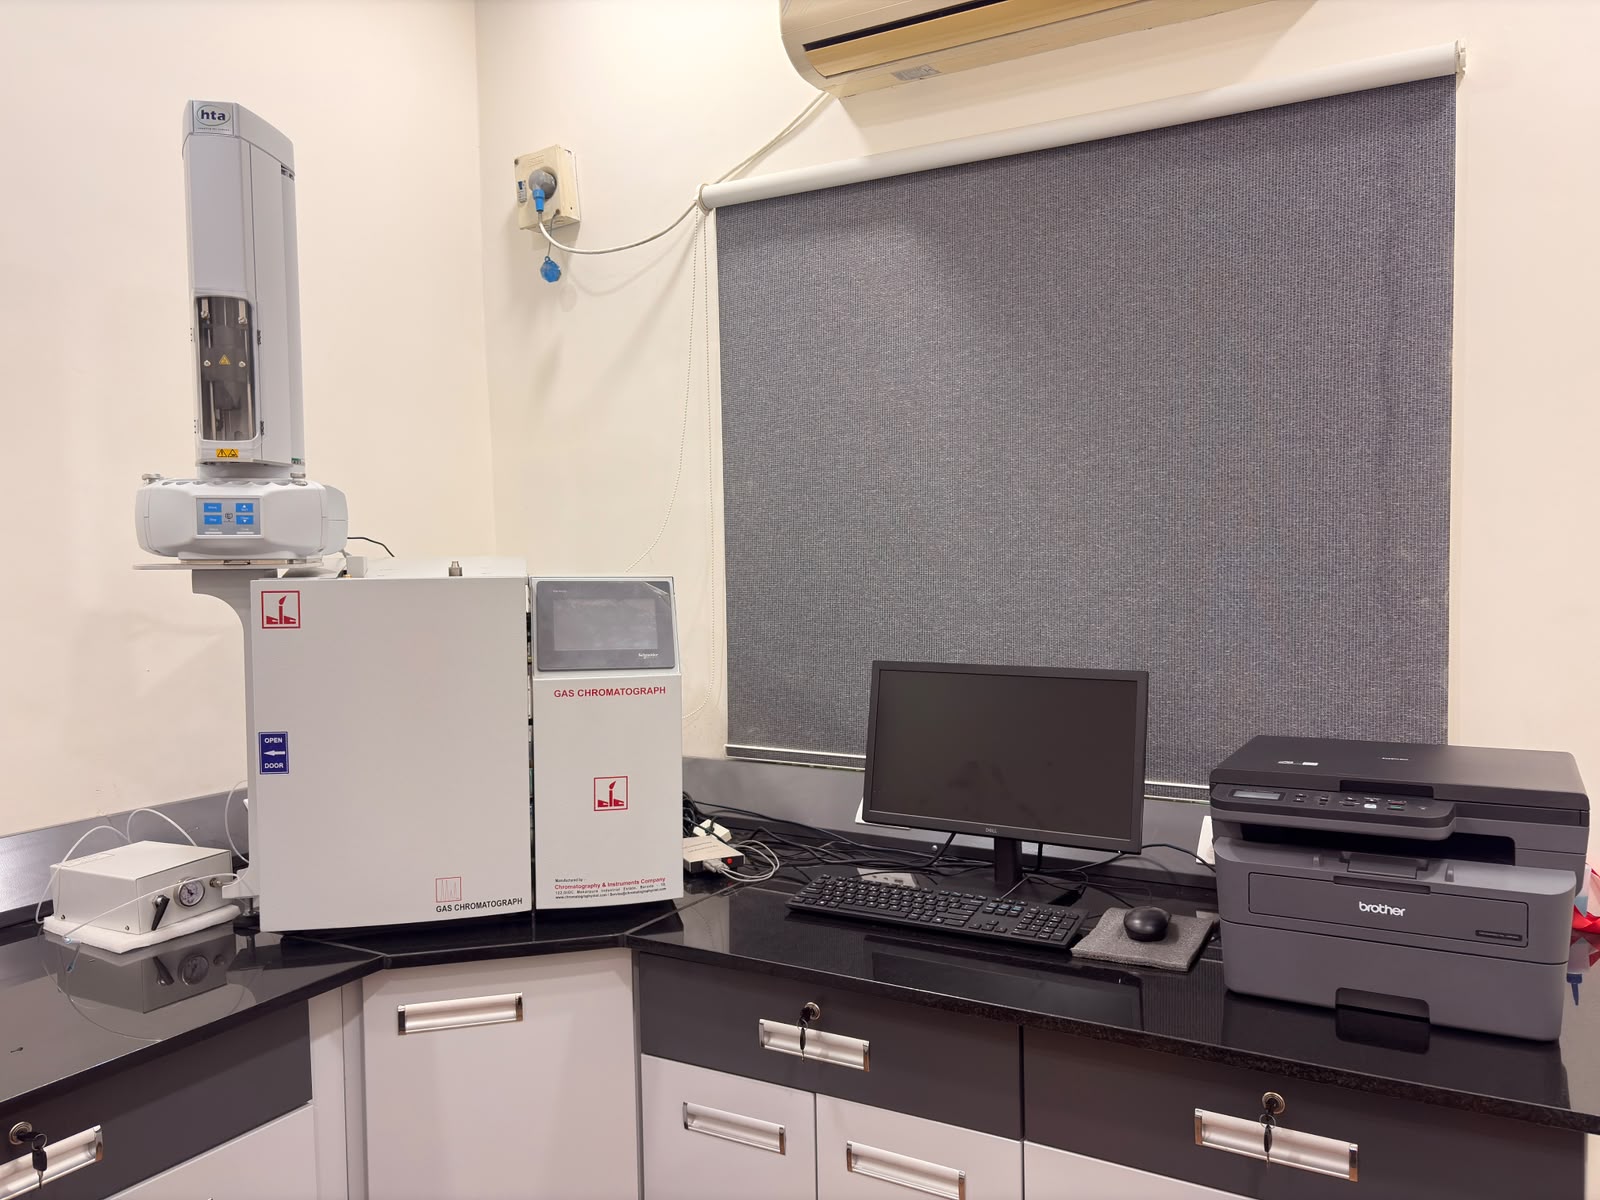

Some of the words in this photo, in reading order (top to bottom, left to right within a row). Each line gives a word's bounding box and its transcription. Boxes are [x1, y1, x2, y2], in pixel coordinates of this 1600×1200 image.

[200, 110, 226, 121] hta
[553, 689, 575, 698] GAS
[577, 686, 667, 697] CHROMATOGRAPH
[554, 882, 601, 890] Chromatography
[640, 877, 666, 885] Company
[435, 904, 453, 913] GAS
[454, 897, 523, 911] CHROMATOGRAPH
[1358, 901, 1406, 917] brother
